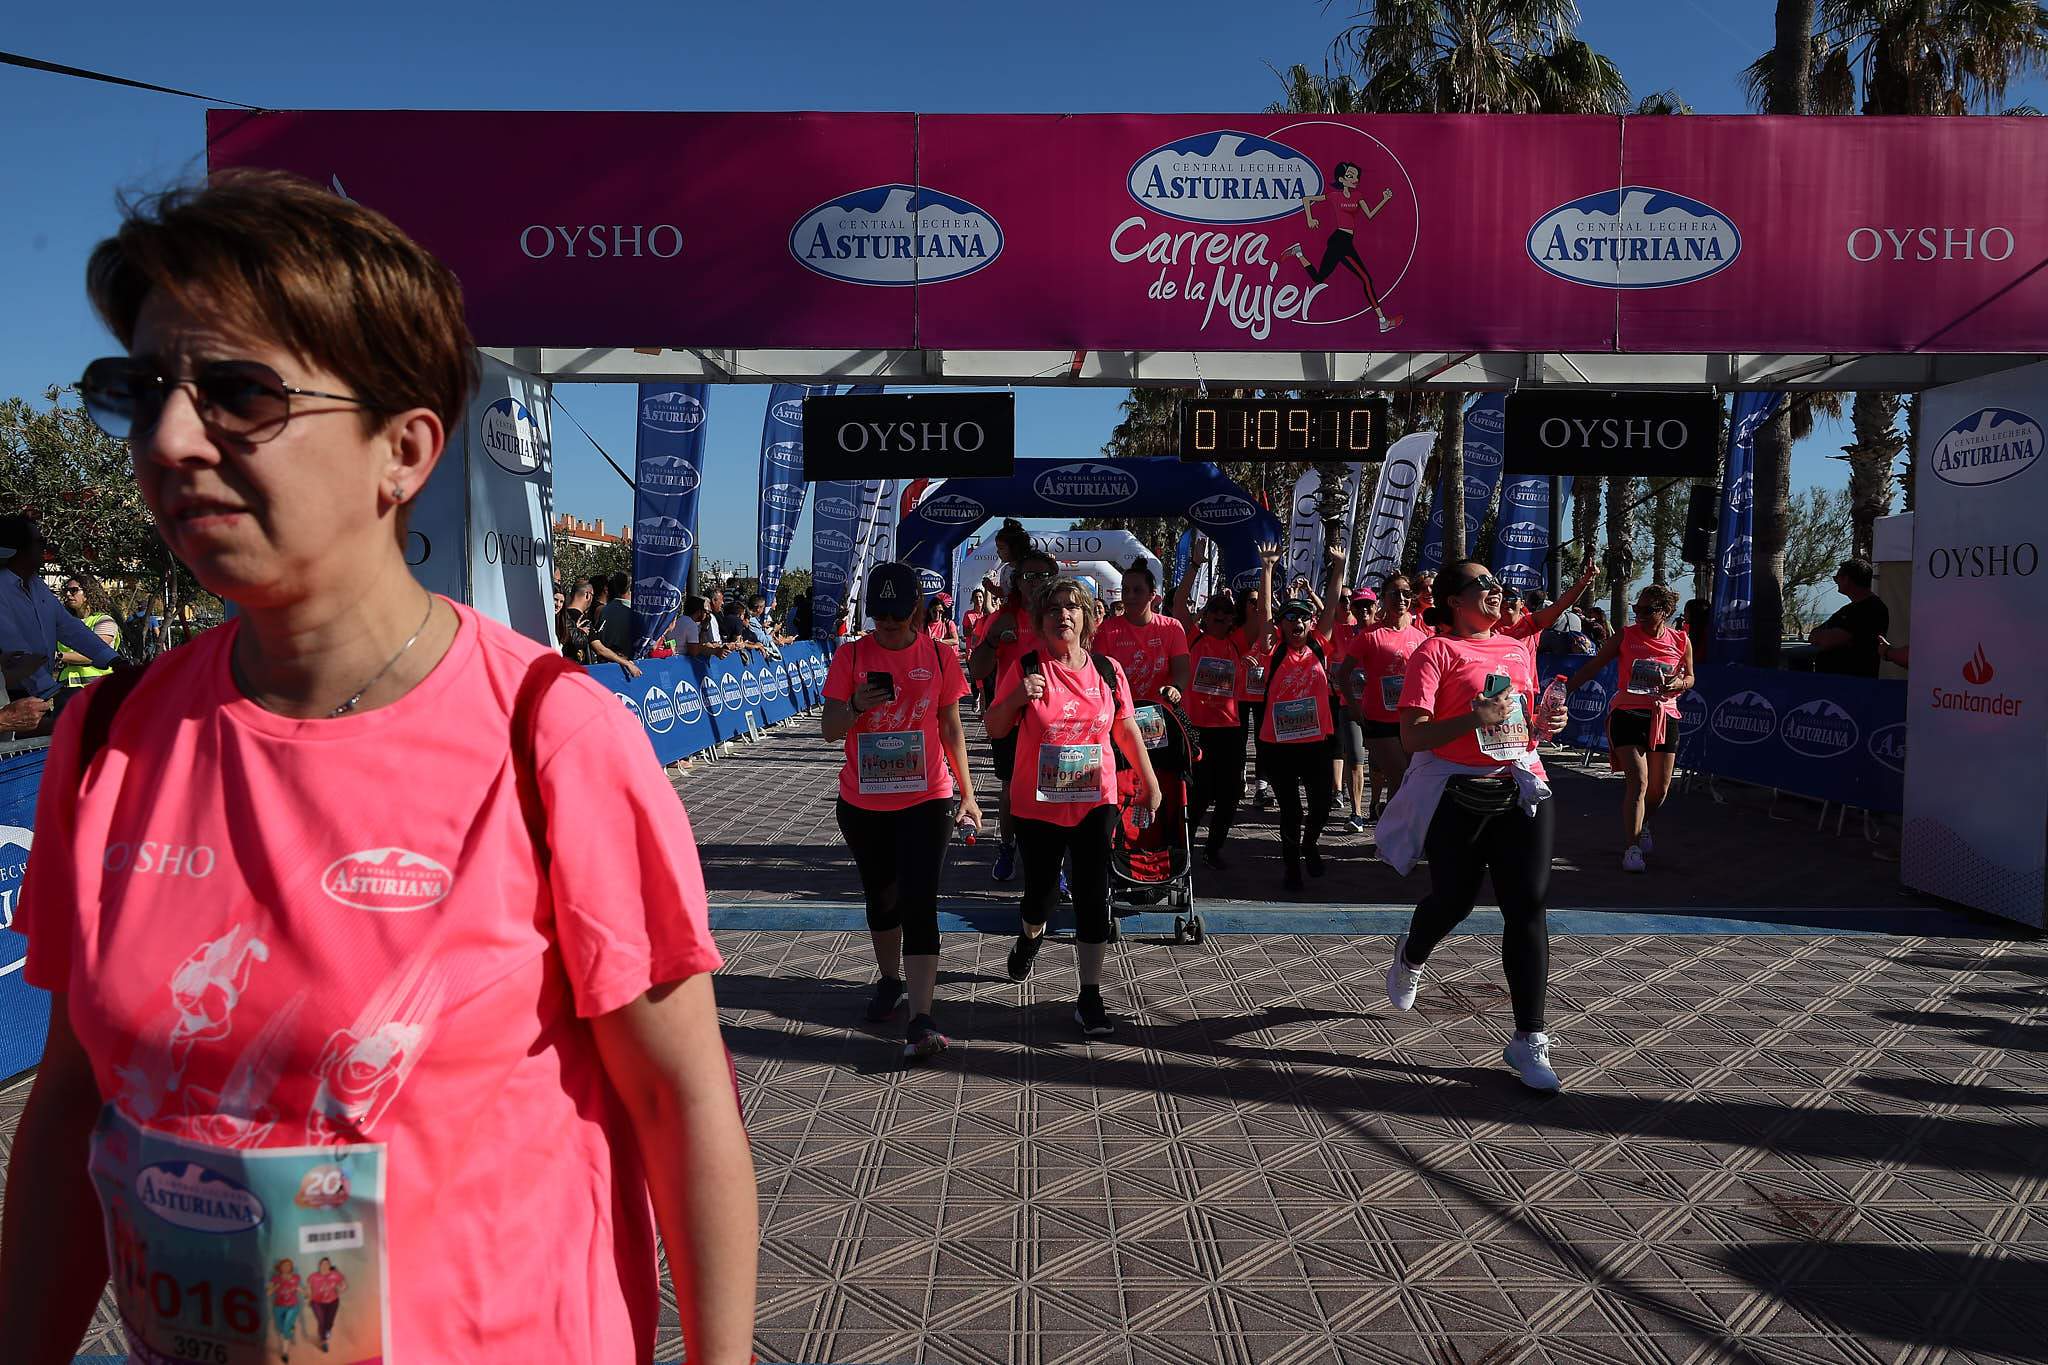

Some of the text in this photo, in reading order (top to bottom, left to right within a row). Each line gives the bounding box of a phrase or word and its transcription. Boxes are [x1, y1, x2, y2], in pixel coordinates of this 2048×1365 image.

[1142, 164, 1306, 200] ASTURIANA
[1173, 162, 1302, 172] CENTRAL LECHERA
[838, 219, 905, 229] CENTRAL
[1576, 222, 1718, 232] CENTRAL LECHERA
[518, 223, 684, 259] OYSHO
[806, 222, 987, 260] ASTURIANA
[1110, 216, 1270, 266] Carrera
[1543, 223, 1725, 262] ASTURIANA
[1847, 227, 2015, 262] OYSHO
[1148, 262, 1328, 340] de la Mujer
[837, 421, 985, 452] OYSHO
[1196, 410, 1371, 450] 01:09:10
[1539, 417, 1688, 450] OYSHO
[1464, 450, 1499, 465] STURIANA
[1938, 438, 2035, 472] ASTURIANA
[1040, 476, 1131, 496] ASTURIANA
[923, 505, 980, 518] ASTURIANA
[1194, 506, 1252, 518] ASTURIANA
[484, 531, 546, 568] OYSHO
[1928, 542, 2039, 580] OYSHO
[1931, 687, 2022, 717] Santander
[1715, 708, 1771, 733] ASTURIANA
[1783, 717, 1849, 747] ASTURIANA
[103, 841, 217, 879] OSHO
[330, 869, 443, 898] ASTURIANA
[142, 1175, 255, 1224] ASTURIANA
